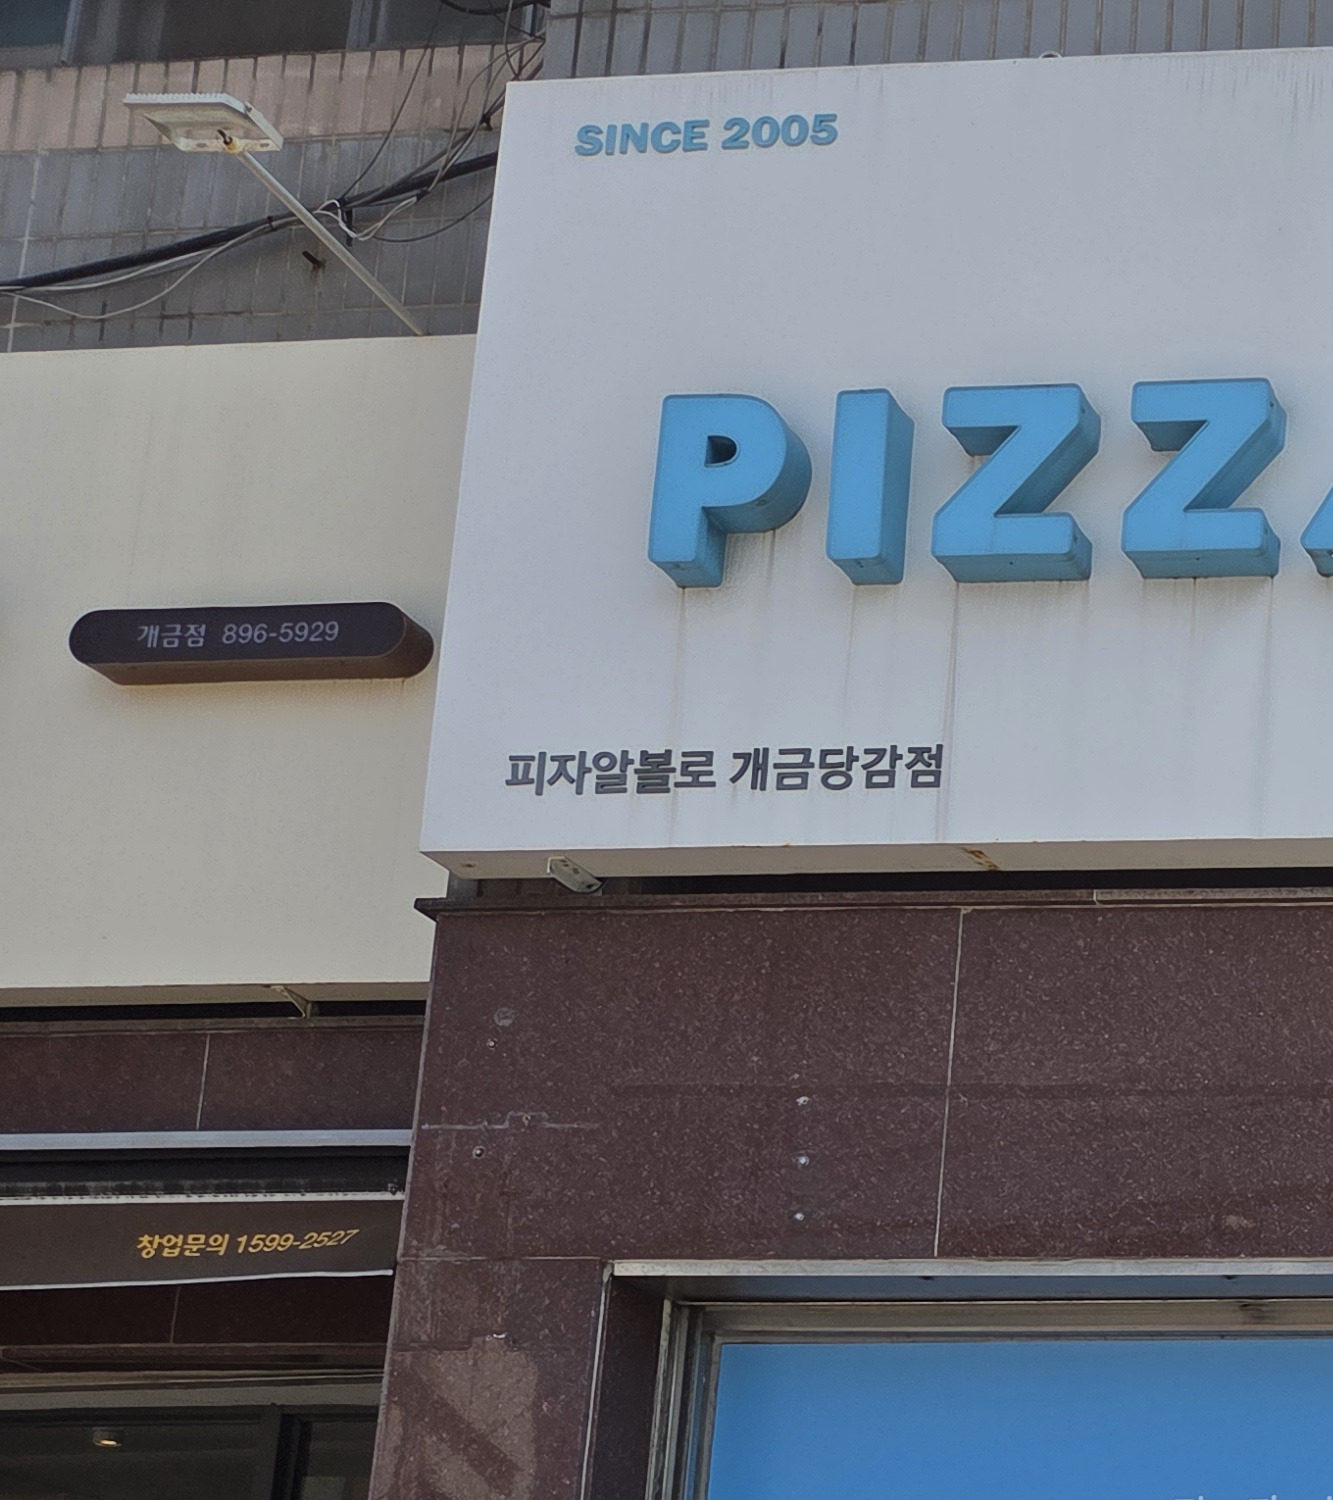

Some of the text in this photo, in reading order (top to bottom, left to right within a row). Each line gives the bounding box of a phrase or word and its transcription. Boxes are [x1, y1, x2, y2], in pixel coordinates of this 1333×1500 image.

[575, 112, 838, 156] SINCE 2005
[136, 620, 340, 649] 개금점 896-5929
[506, 742, 945, 796] 피자알볼로 개금당감점
[136, 1228, 361, 1259] 창업문의 1599-2527
